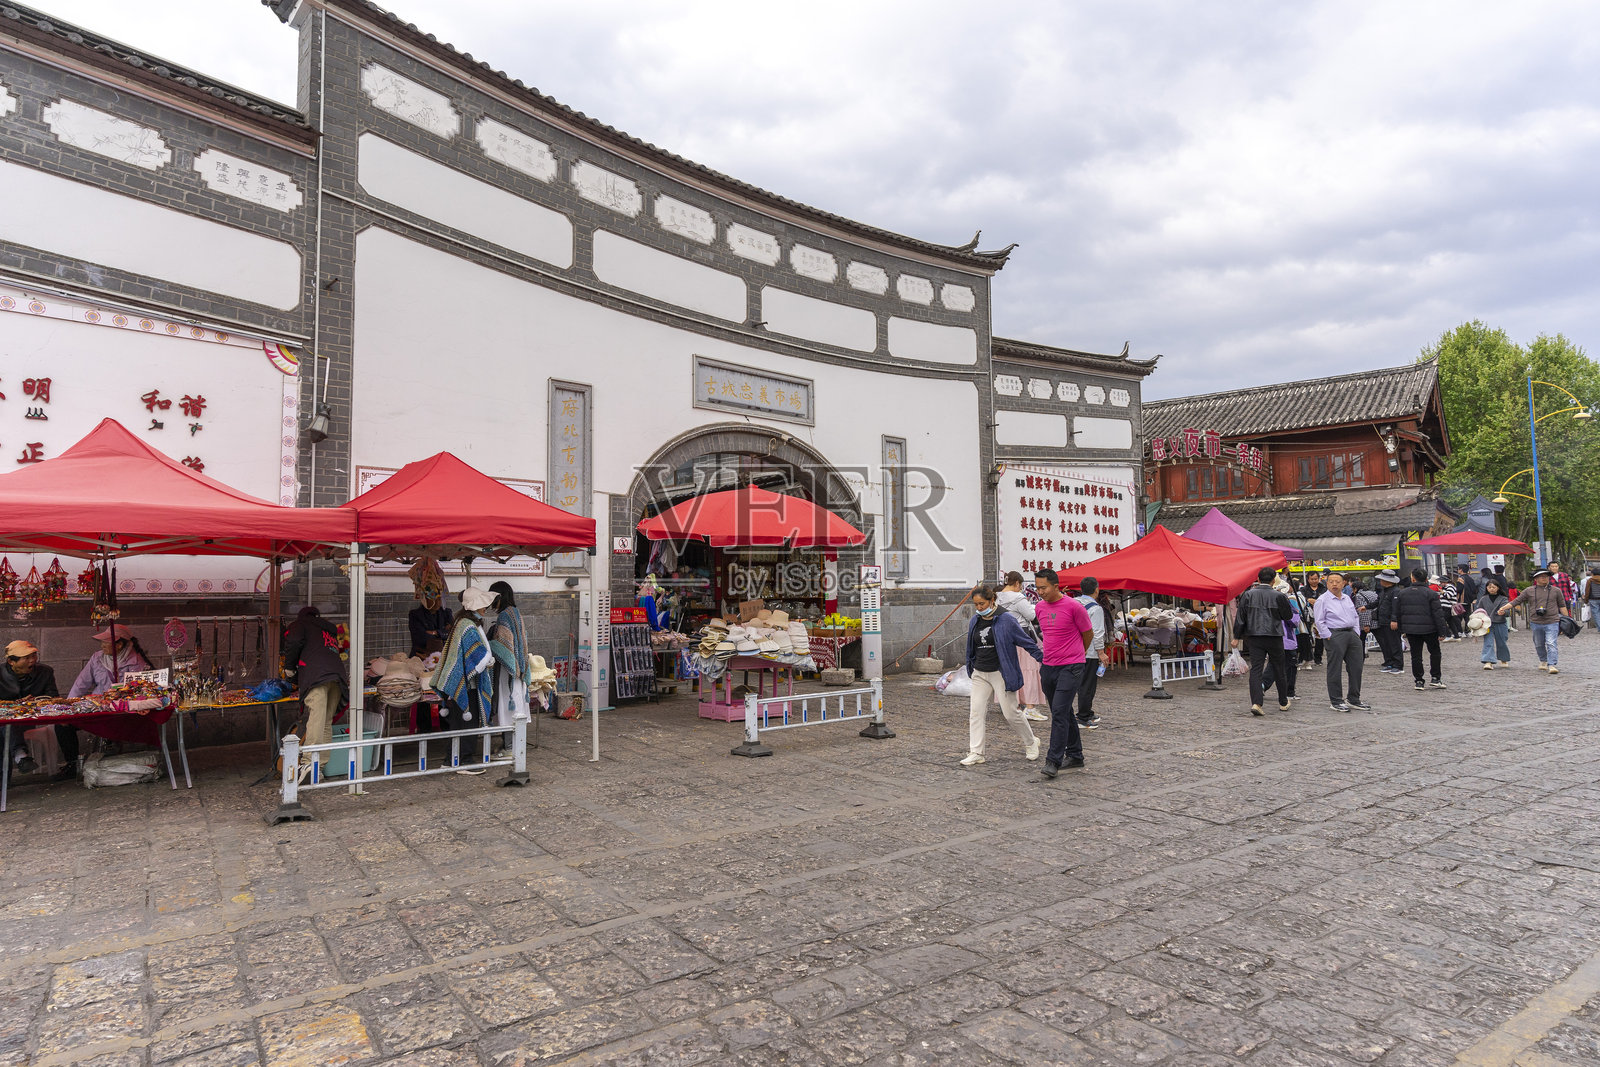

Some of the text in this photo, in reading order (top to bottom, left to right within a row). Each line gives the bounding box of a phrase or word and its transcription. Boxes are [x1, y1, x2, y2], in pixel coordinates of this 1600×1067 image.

[140, 388, 208, 419] 和谐
[1151, 427, 1264, 472] 忠义夜市一条街
